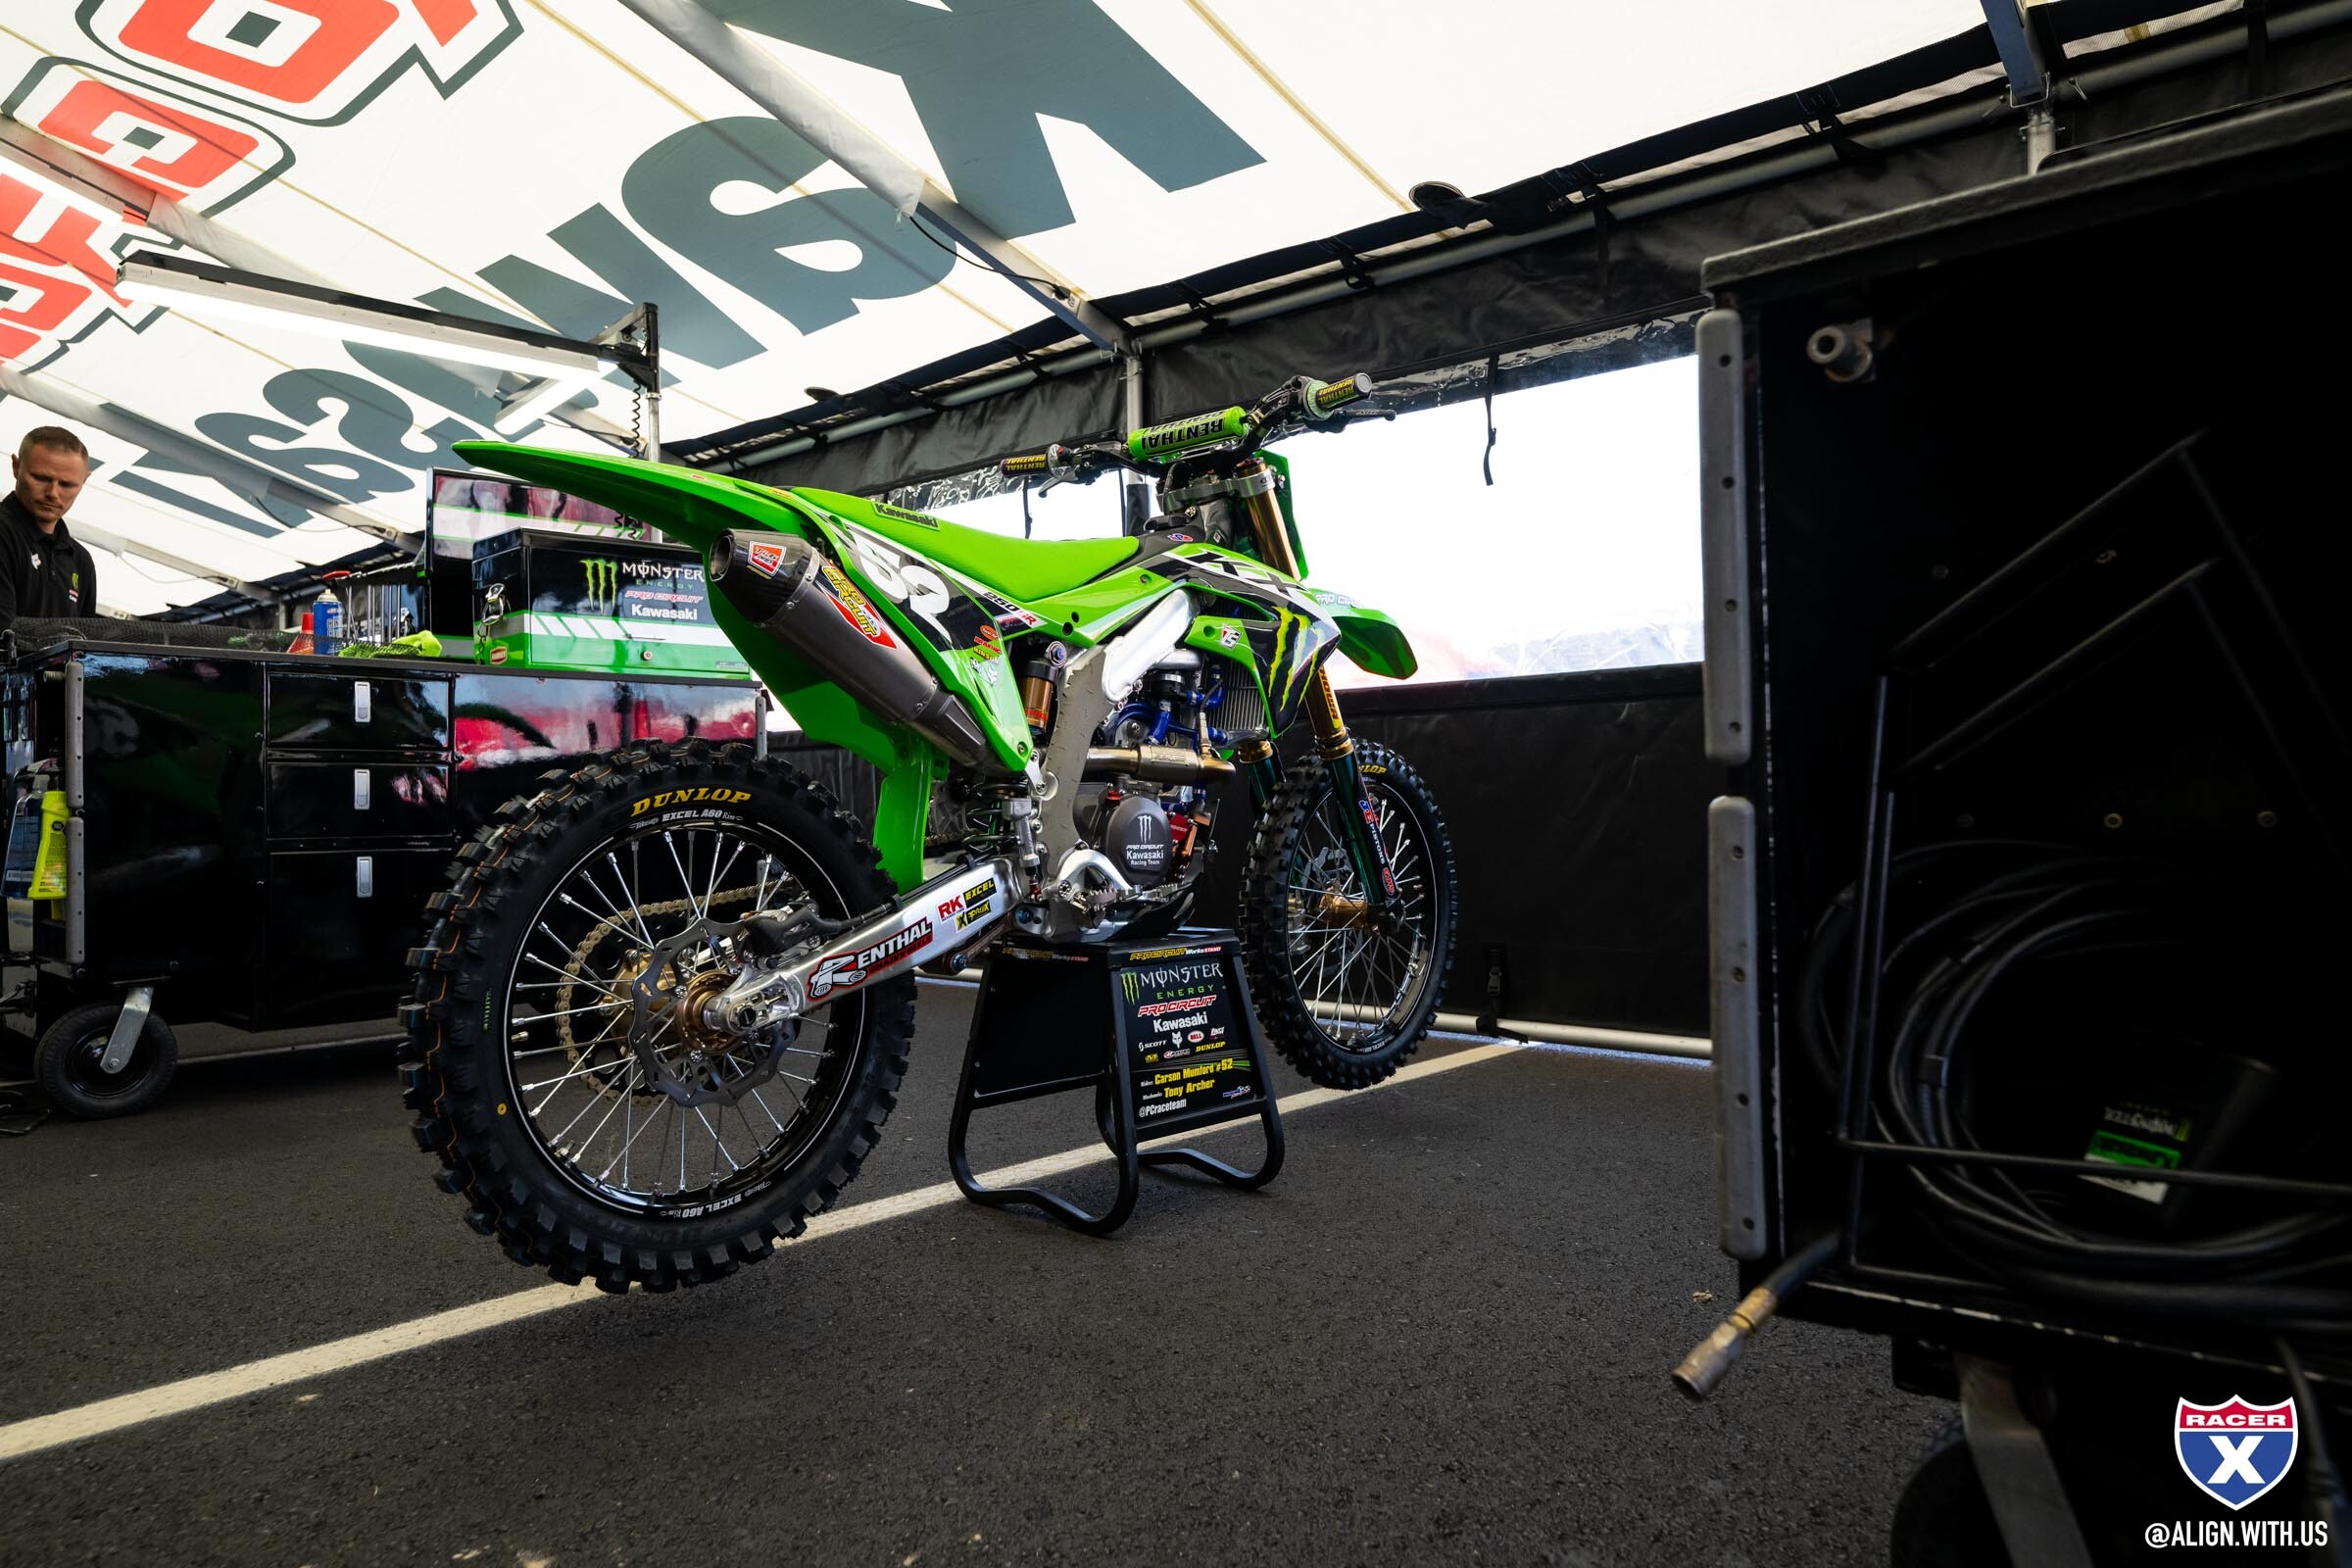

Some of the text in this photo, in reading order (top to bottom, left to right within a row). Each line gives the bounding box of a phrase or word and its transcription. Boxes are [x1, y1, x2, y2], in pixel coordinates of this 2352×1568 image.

[875, 504, 939, 528] Kawasaki
[621, 560, 706, 582] MONSTER
[1184, 552, 1309, 598] KX
[636, 578, 694, 590] ENERGY
[631, 604, 698, 620] Kawasaki
[631, 788, 752, 816] DUNLOP
[662, 809, 699, 822] EXCEL
[701, 808, 723, 818] A60
[1370, 823, 1385, 864] PISTONS
[1127, 850, 1163, 858] Kawasaki
[965, 880, 994, 901] EXCEL
[938, 895, 963, 919] RK
[1141, 962, 1223, 988] MONSTER
[1156, 984, 1214, 1000] ENERGY
[1138, 995, 1217, 1017] PRO CIRCUIT
[1152, 1011, 1208, 1033] Kawasaki
[1144, 1040, 1167, 1049] SCOTT
[1196, 1041, 1226, 1053] DUNLOP
[1154, 1071, 1181, 1085] Carson
[1183, 1062, 1214, 1079] Mumford
[1164, 1086, 1184, 1099] Tony
[1186, 1079, 1215, 1093] Archer
[1139, 1099, 1187, 1117] @PCraceteam
[682, 1206, 705, 1218] A60
[705, 1193, 742, 1212] EXCEL
